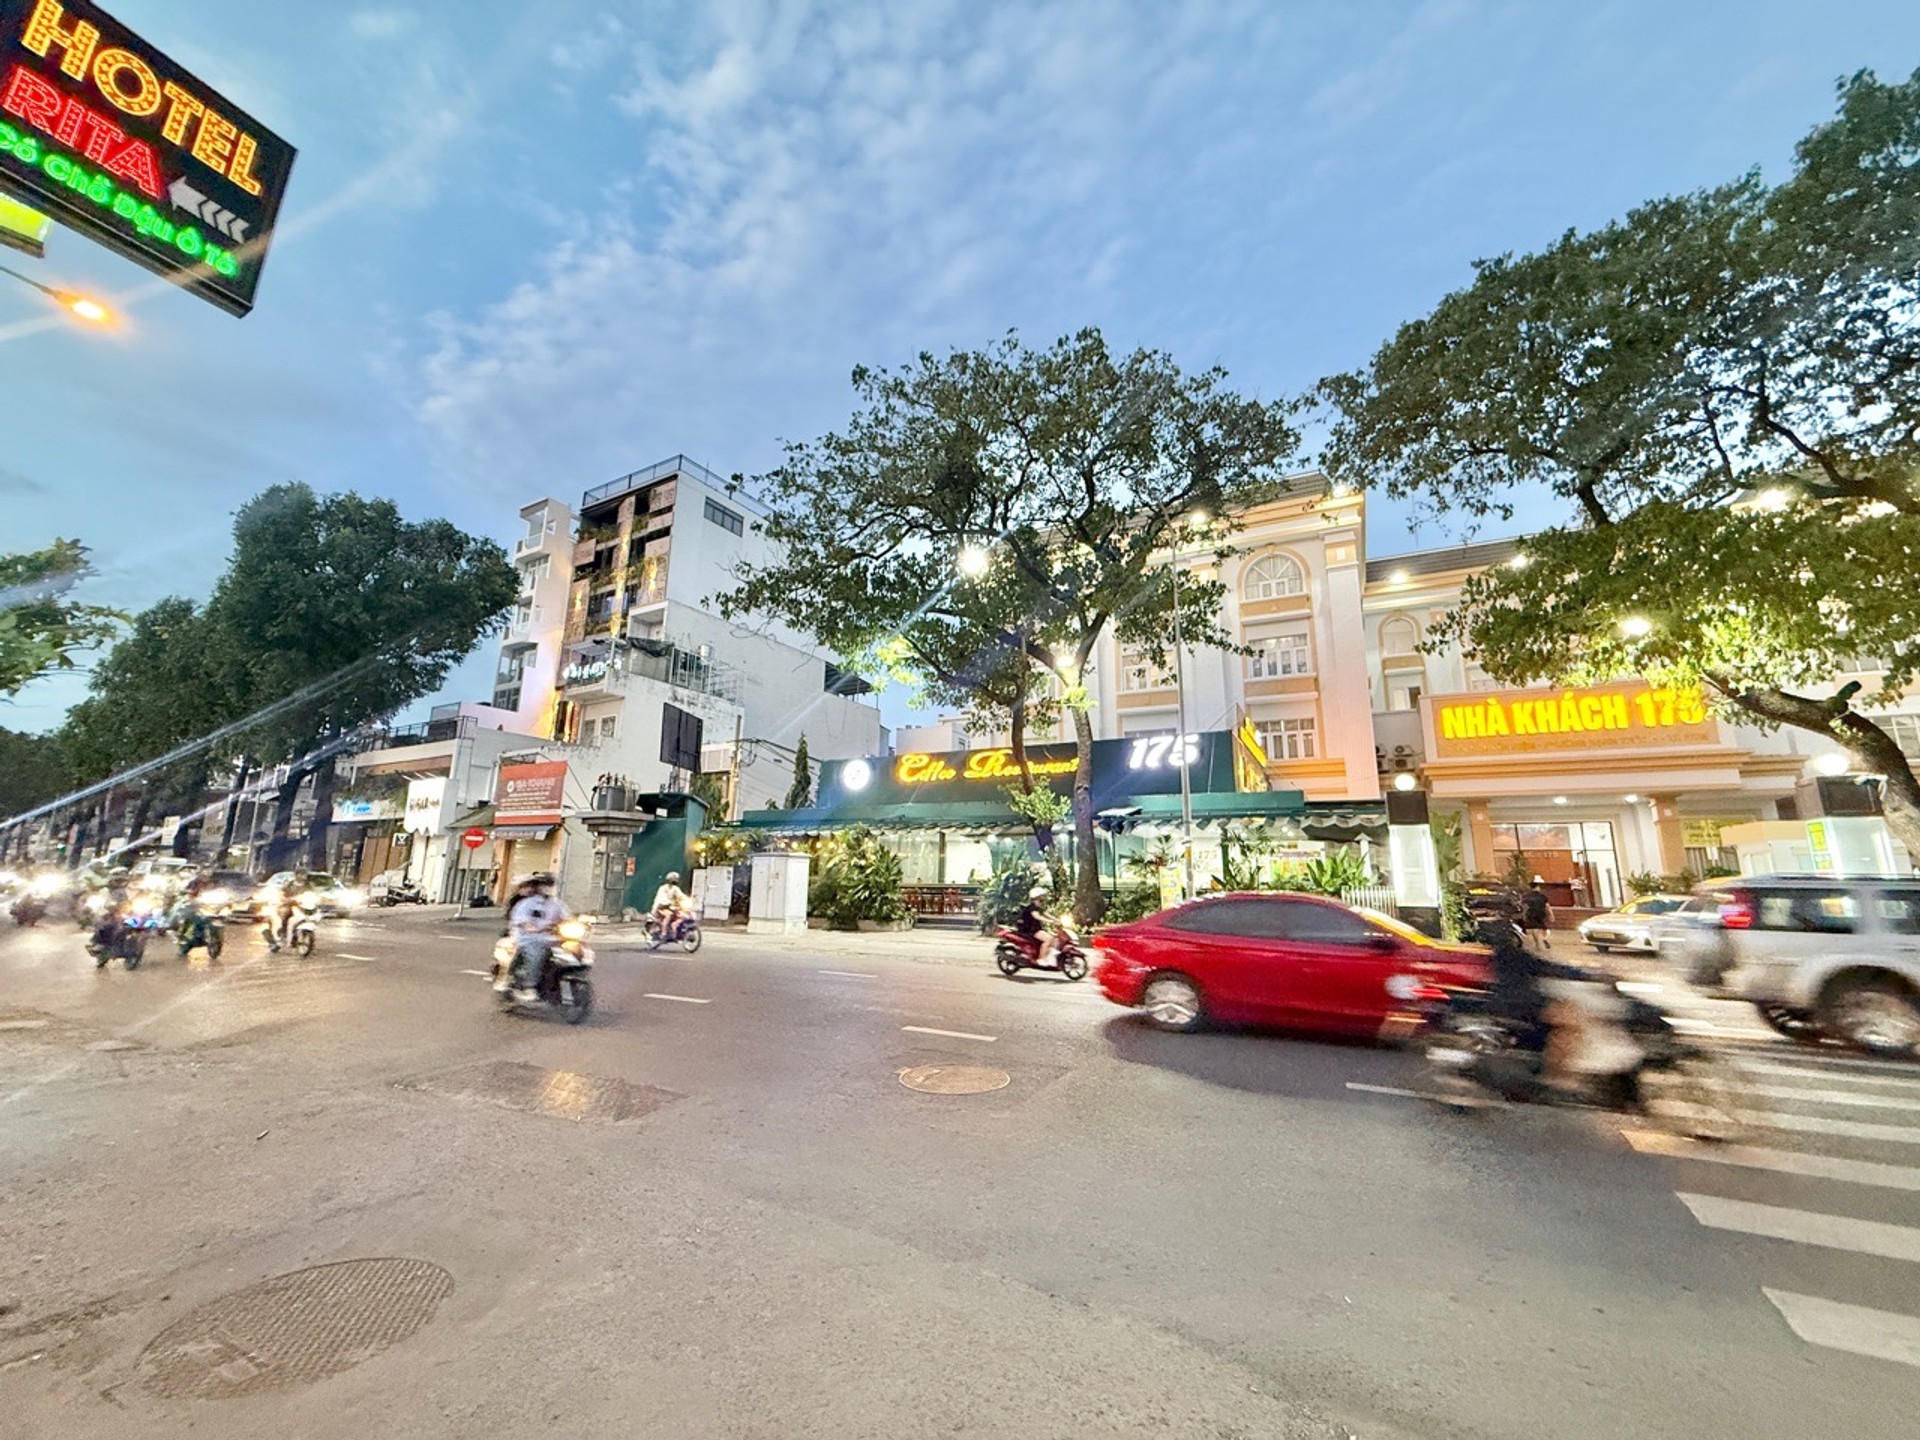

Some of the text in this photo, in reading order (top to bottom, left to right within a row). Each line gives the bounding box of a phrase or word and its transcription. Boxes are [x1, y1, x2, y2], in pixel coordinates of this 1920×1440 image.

[21, 0, 261, 196] HOTEL
[2, 66, 162, 199] RITA
[1441, 697, 1509, 739] NHÀ
[1512, 691, 1629, 735] KHÁCH
[899, 754, 956, 782] Coffee
[1129, 734, 1199, 769] 175
